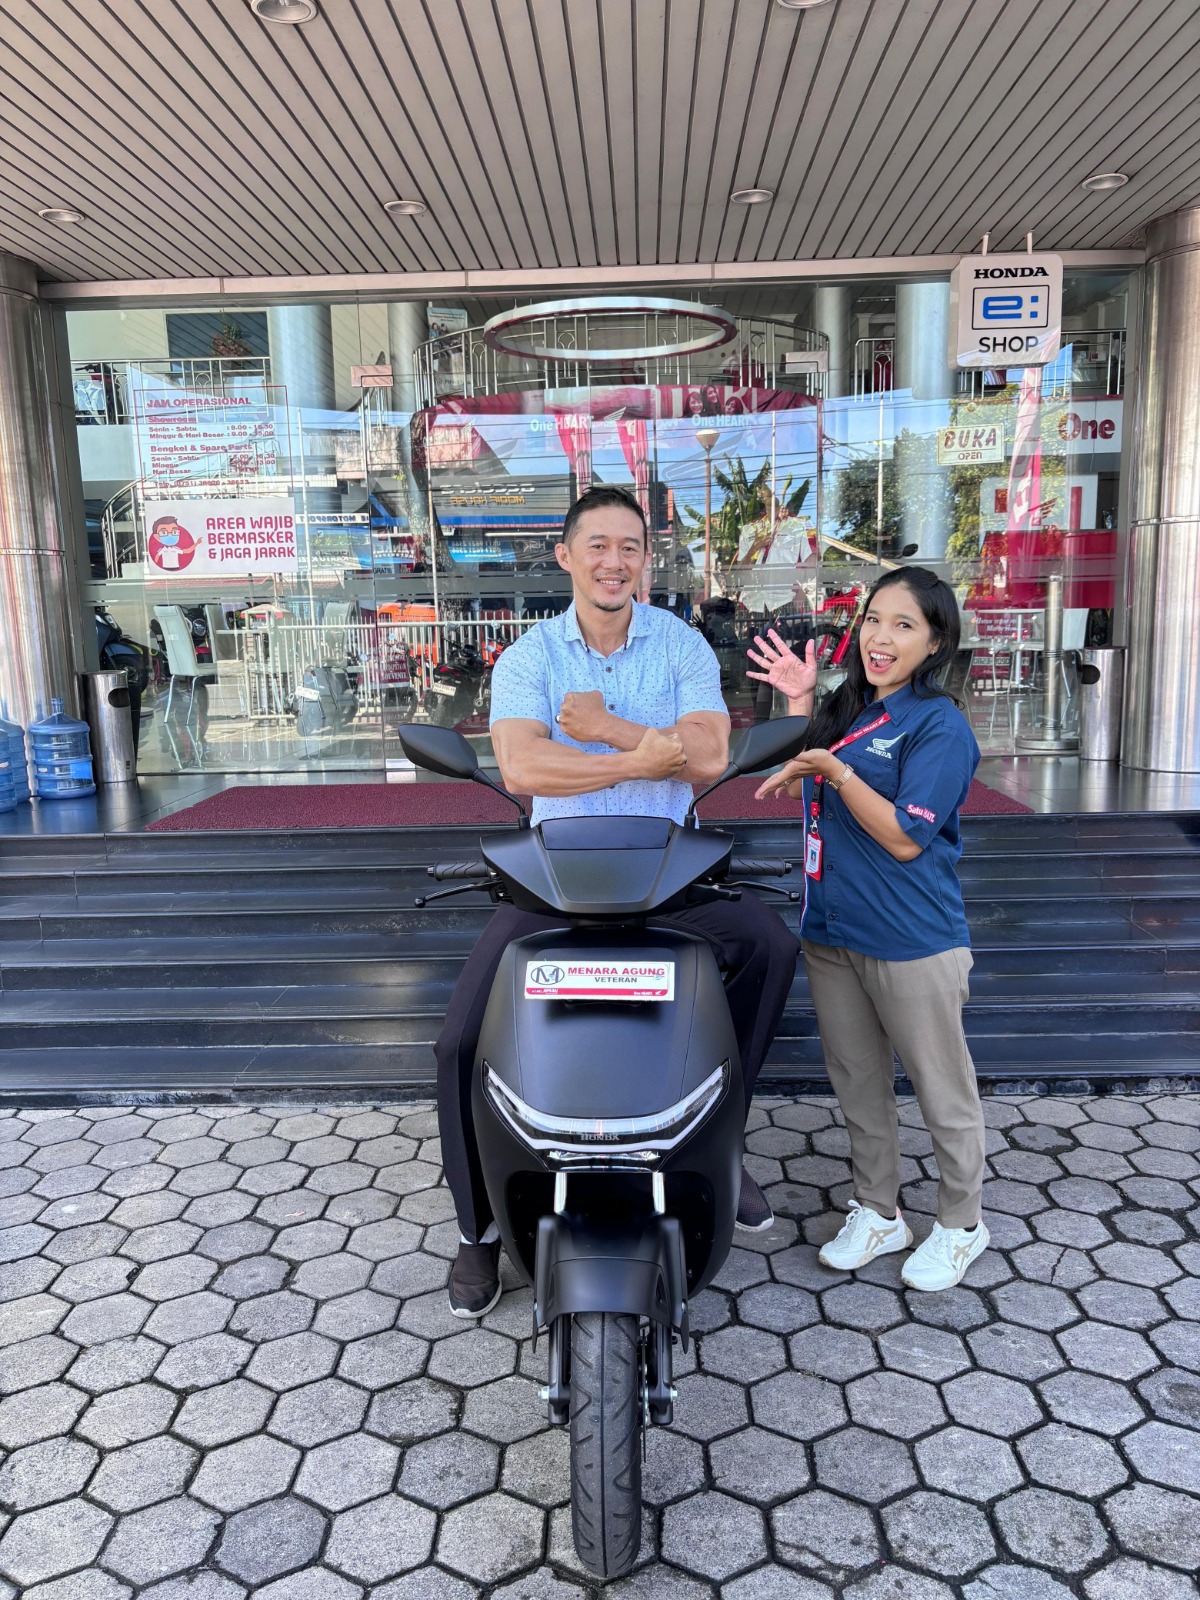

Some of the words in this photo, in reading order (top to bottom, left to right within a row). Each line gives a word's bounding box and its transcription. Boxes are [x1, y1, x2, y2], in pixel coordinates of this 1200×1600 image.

[974, 267, 1049, 279] HONDA
[979, 336, 1039, 353] SHOP
[147, 399, 170, 408] JAM
[173, 397, 252, 407] OPERASIONAL
[529, 419, 553, 432] One
[691, 414, 714, 427] One
[1058, 412, 1115, 441] One
[944, 427, 997, 449] BUKA
[150, 444, 188, 453] Bengkel
[200, 444, 227, 453] Spare
[228, 443, 253, 451] Parts
[957, 452, 983, 460] OPEN
[206, 517, 246, 530] AREA
[250, 515, 293, 531] WAJIB
[207, 531, 294, 545] BERMASKER
[208, 548, 217, 559] &
[220, 547, 252, 561] JAGA
[255, 546, 295, 560] JARAK
[864, 746, 892, 760] HONDA
[907, 804, 924, 816] Satu
[567, 967, 619, 975] MENARA
[622, 967, 665, 976] AGUNG
